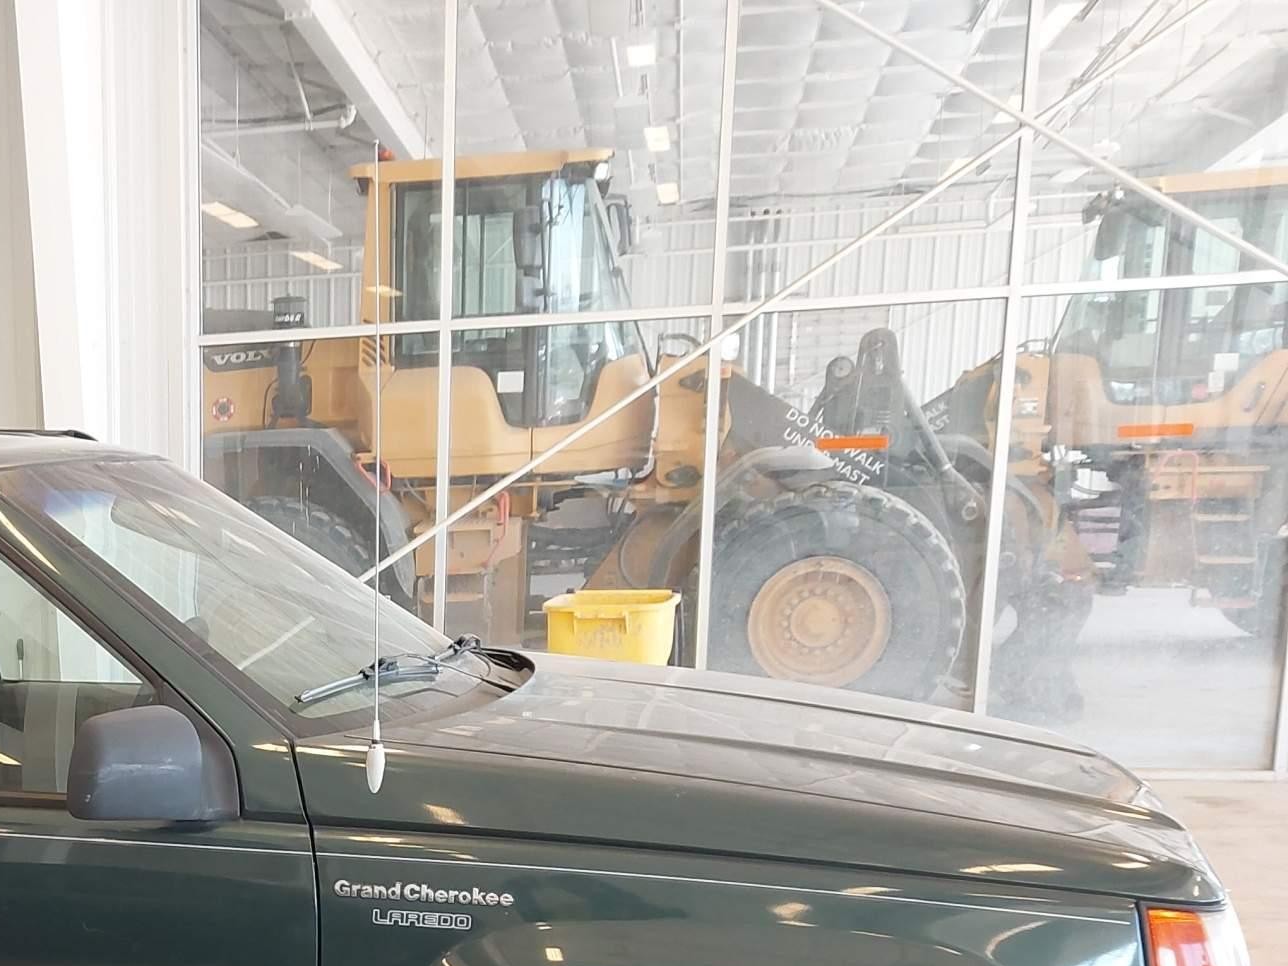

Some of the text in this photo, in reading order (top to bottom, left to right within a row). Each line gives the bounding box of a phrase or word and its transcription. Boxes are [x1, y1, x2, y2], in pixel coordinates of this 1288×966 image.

[211, 349, 269, 366] VOL
[785, 407, 810, 427] DO
[808, 422, 840, 440] NO
[844, 448, 886, 475] WALK
[832, 457, 871, 486] MAST
[372, 908, 472, 930] LAREDO
